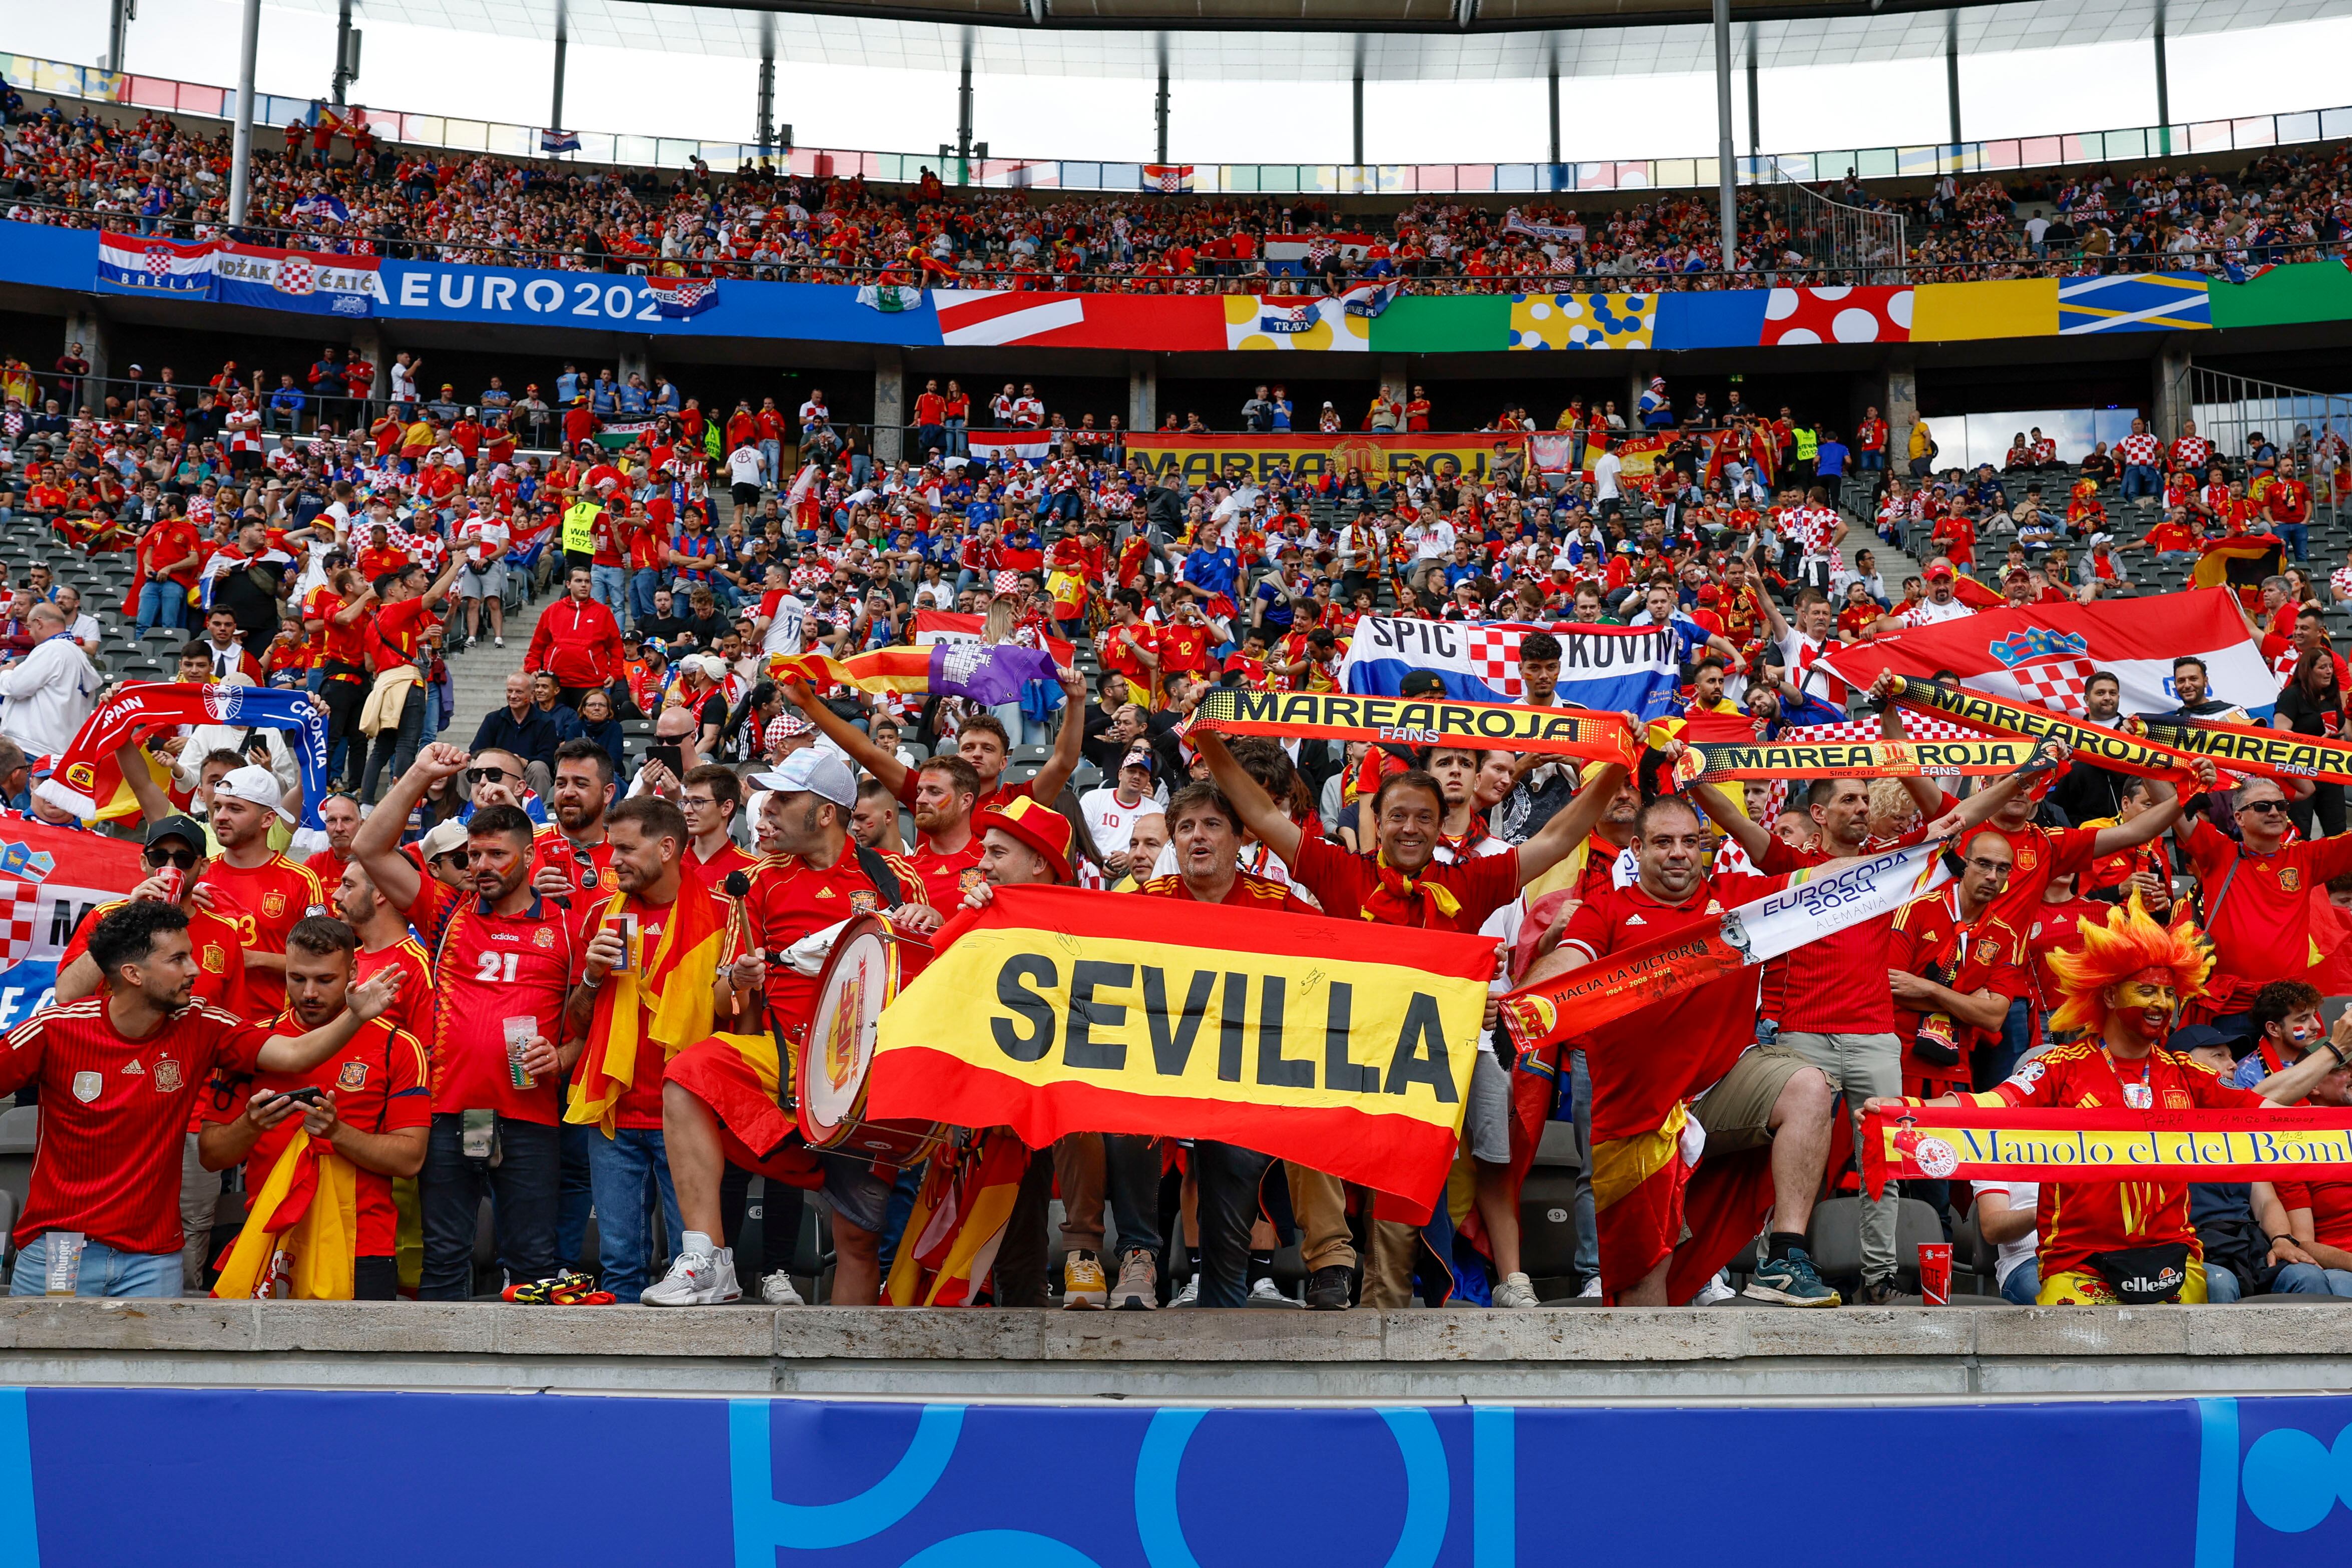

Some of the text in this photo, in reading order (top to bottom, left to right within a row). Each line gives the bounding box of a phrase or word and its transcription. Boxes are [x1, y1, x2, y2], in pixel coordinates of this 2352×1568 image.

[121, 272, 194, 289] BRELA
[880, 382, 899, 404] K
[1894, 385, 1913, 403] K
[787, 615, 802, 641] 17
[1116, 644, 1126, 658] 14
[1179, 641, 1192, 655] 12
[1234, 693, 1579, 743] MAREAROJA
[1931, 689, 2174, 769] MAREAROJA
[2035, 709, 2079, 726] Desde 2012
[289, 701, 328, 768] CROATIA
[1379, 725, 1440, 743] FANS
[2306, 738, 2324, 746] 2012
[1729, 744, 2016, 769] MAREA ROJA
[2173, 727, 2352, 776] MAREAR
[1920, 767, 1961, 776] FANS
[2274, 762, 2318, 777] FANS
[1101, 812, 1119, 828] 10
[1764, 851, 1908, 917] EUROCOPA
[1804, 878, 1877, 917] 2024
[1816, 896, 1887, 931] ALEMANIA
[491, 932, 519, 942] adidas
[476, 950, 520, 982] 21
[1553, 938, 1708, 1004] HACIA LA VICTORIA
[1606, 985, 1623, 997] 1964
[1629, 977, 1648, 989] 2008
[1652, 967, 1672, 979] 2012
[990, 953, 1460, 1104] SEVILLA
[1514, 995, 1550, 1040] MRF
[834, 978, 855, 1093] MRF
[1960, 1129, 2113, 1165] Manolo
[2128, 1132, 2159, 1165] el
[2176, 1132, 2232, 1165] del
[1922, 1158, 1952, 1174] MANOLO
[1554, 1212, 1560, 1220] 9
[51, 1240, 71, 1291] Bitburger
[2121, 1271, 2183, 1292] ellesse
